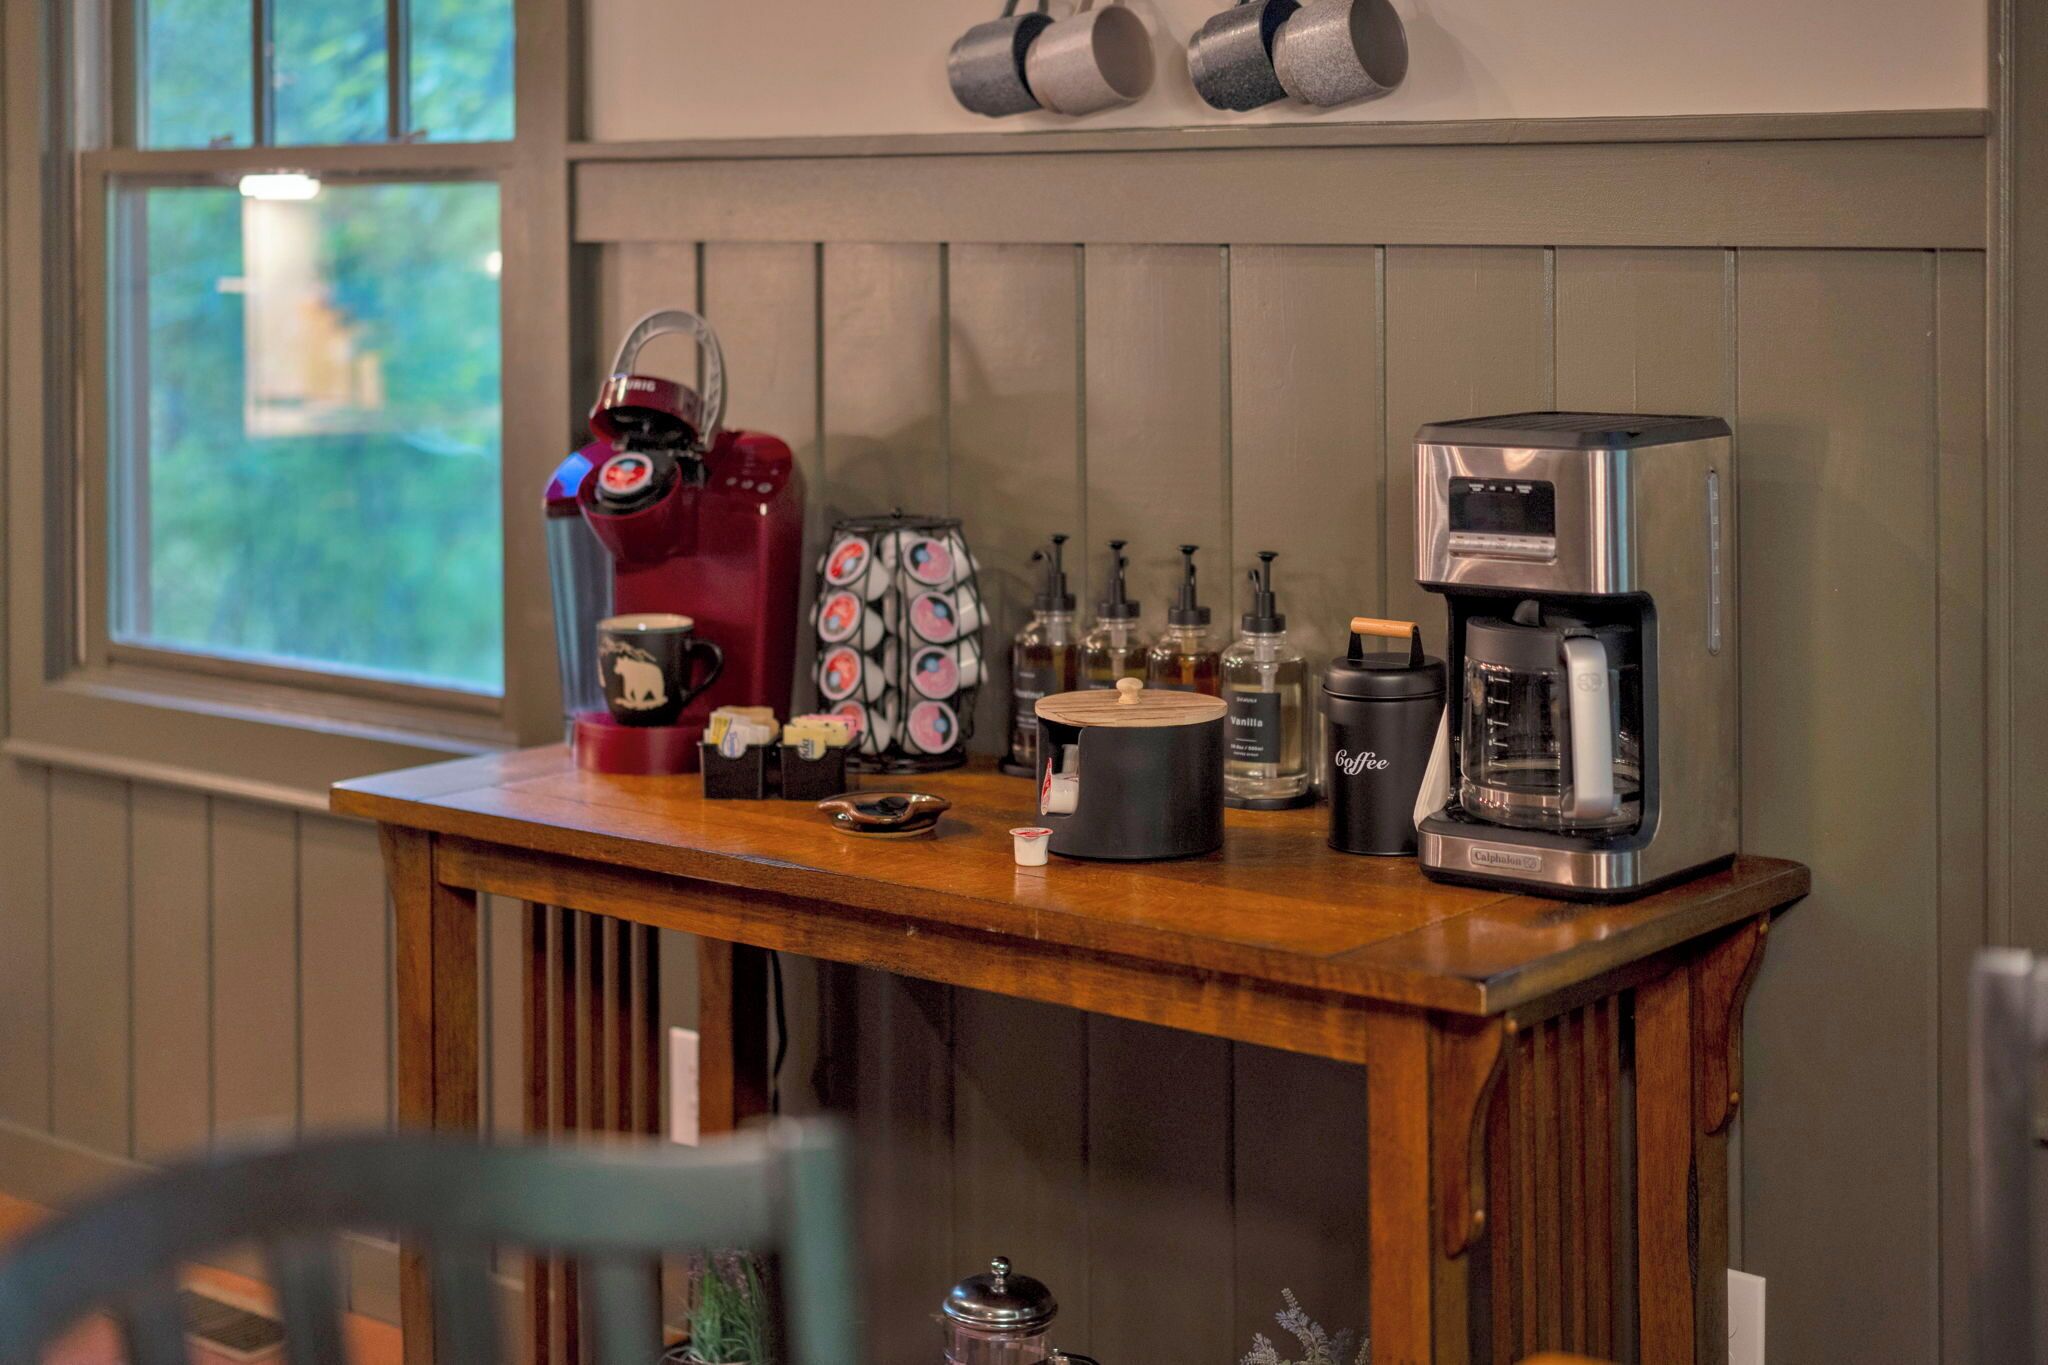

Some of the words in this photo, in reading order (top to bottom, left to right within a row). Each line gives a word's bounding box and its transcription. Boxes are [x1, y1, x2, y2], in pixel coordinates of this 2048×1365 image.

[1230, 716, 1263, 727] Vanilla
[1335, 749, 1390, 776] Coffee
[1475, 851, 1522, 866] Calphalon
